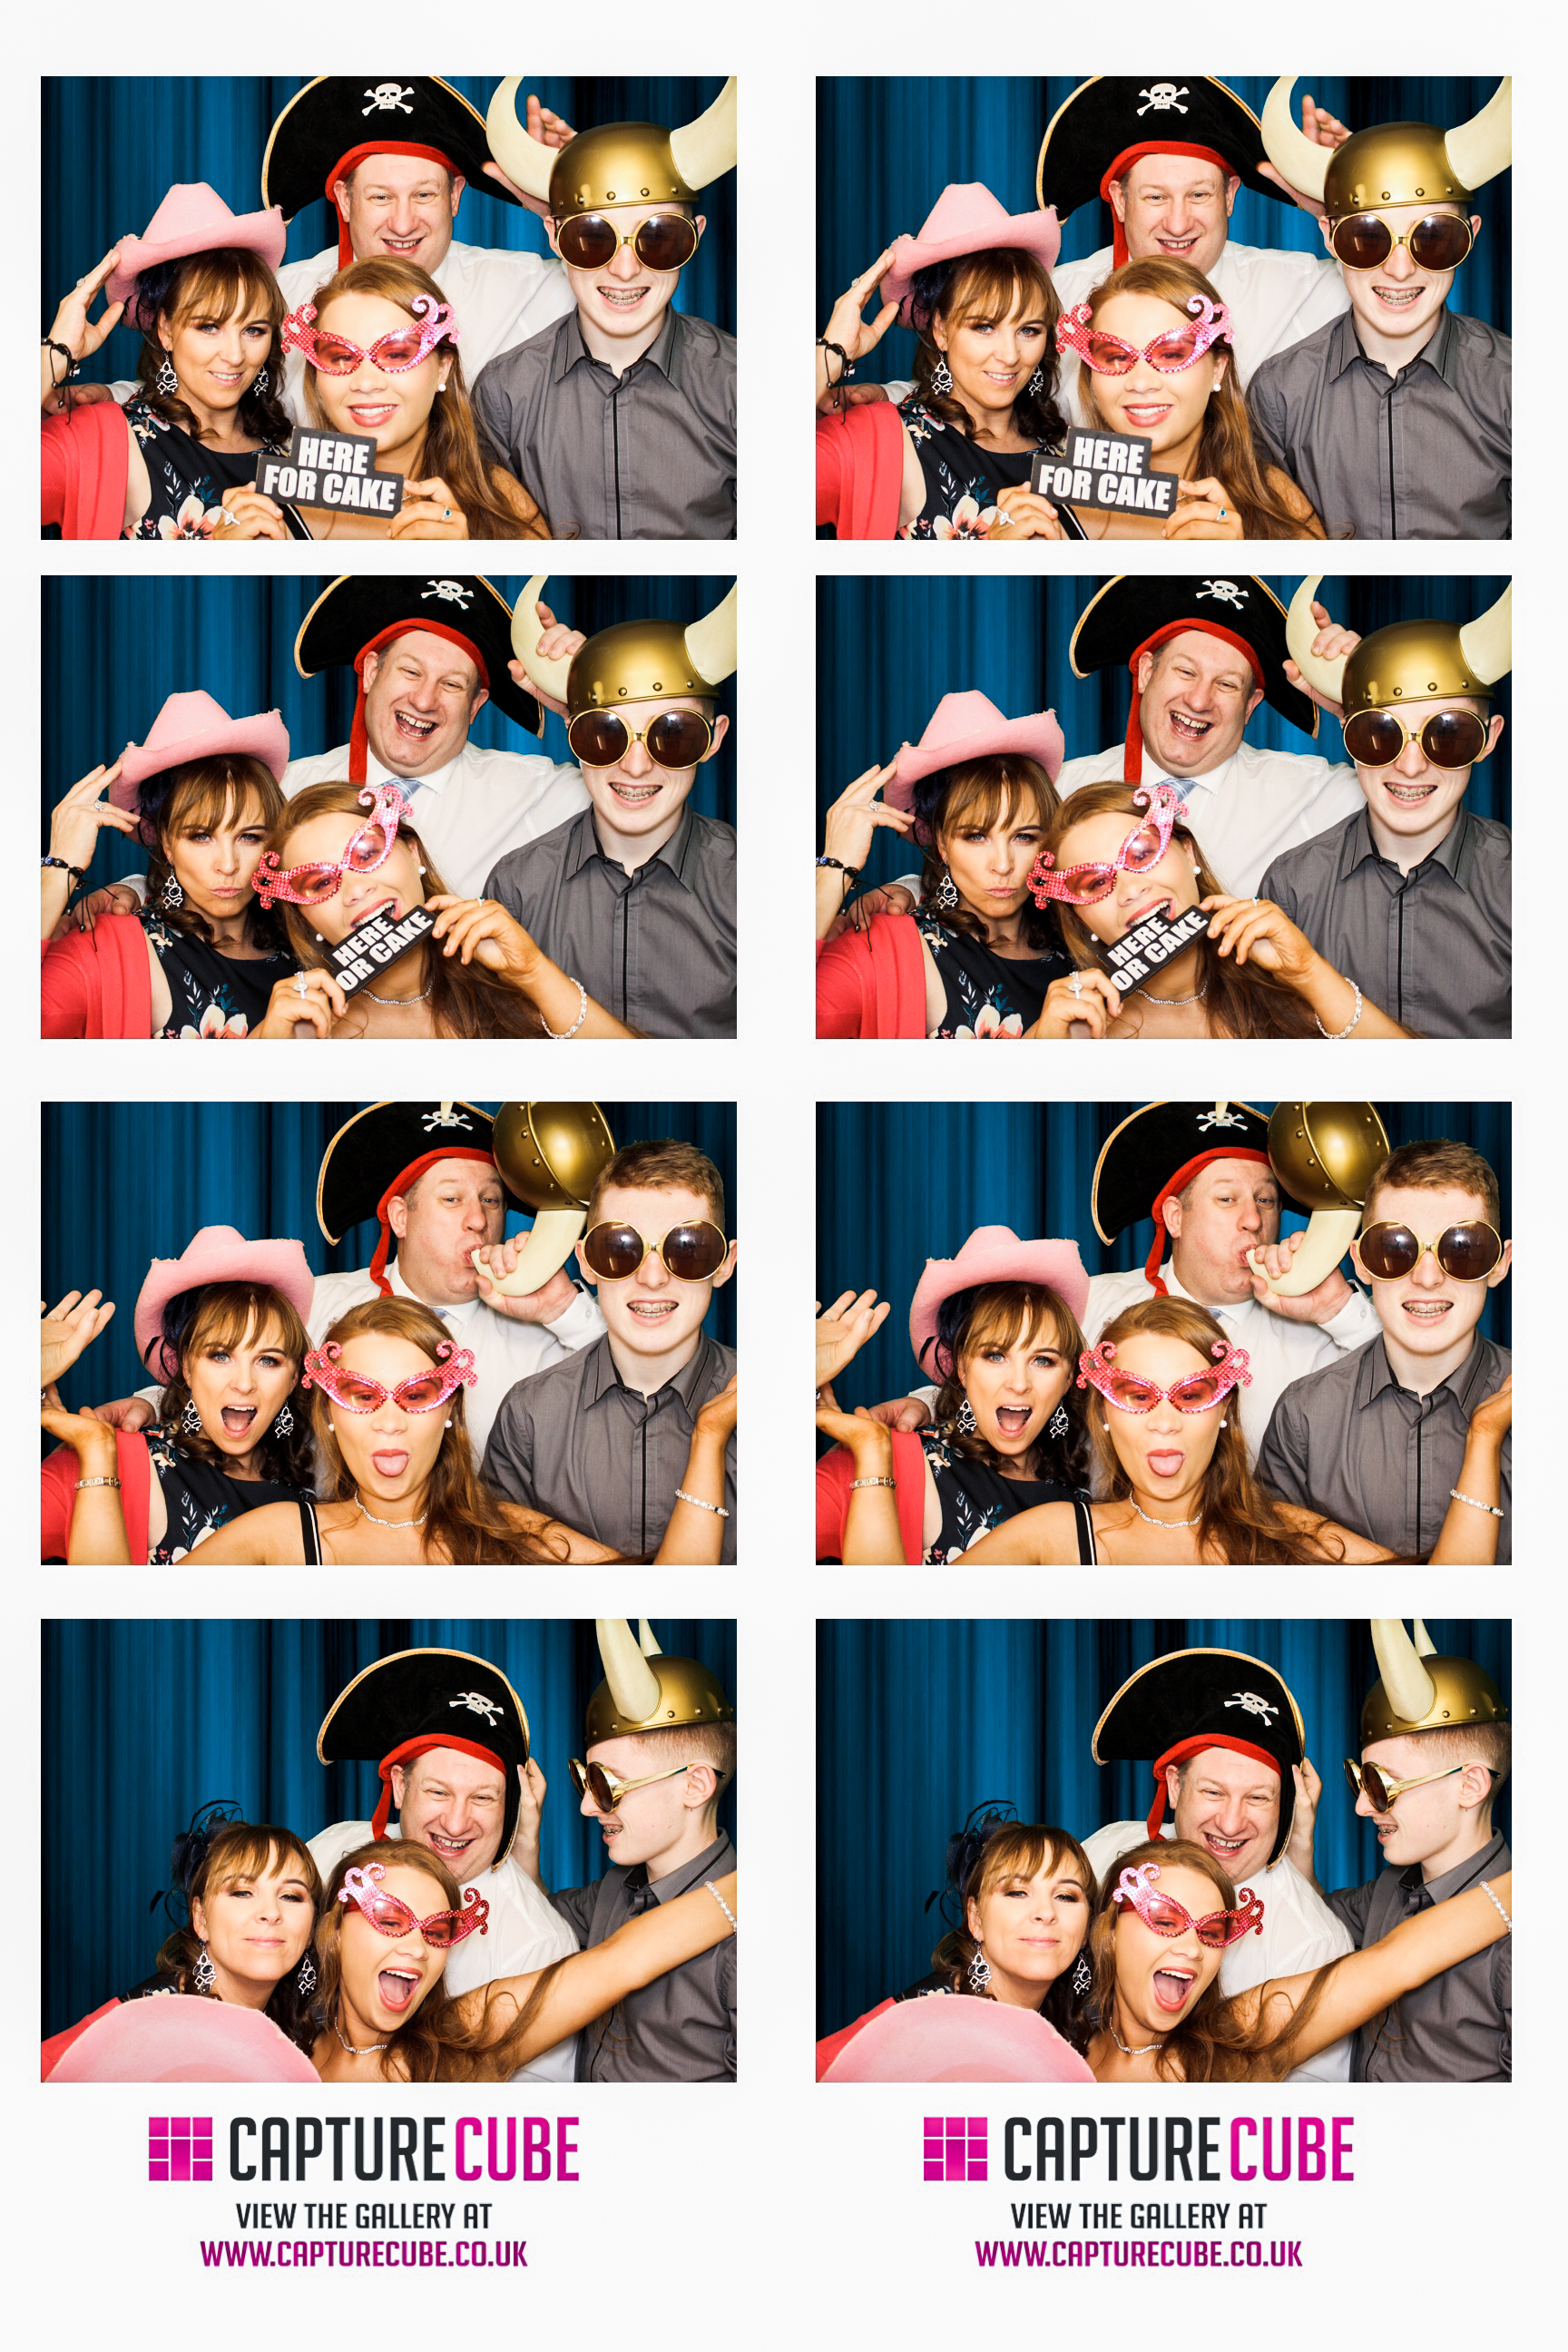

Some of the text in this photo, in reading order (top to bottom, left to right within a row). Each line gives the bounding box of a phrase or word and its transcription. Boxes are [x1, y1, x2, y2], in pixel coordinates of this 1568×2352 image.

[298, 436, 370, 475] HERE
[1073, 436, 1145, 475] HERE
[263, 464, 397, 512] FOR CAKE
[1038, 464, 1172, 512] FOR CAKE
[332, 916, 395, 967] HERE
[335, 911, 434, 991] OR CAKE
[1107, 916, 1170, 967] HERE
[1110, 911, 1209, 991] OR CAKE
